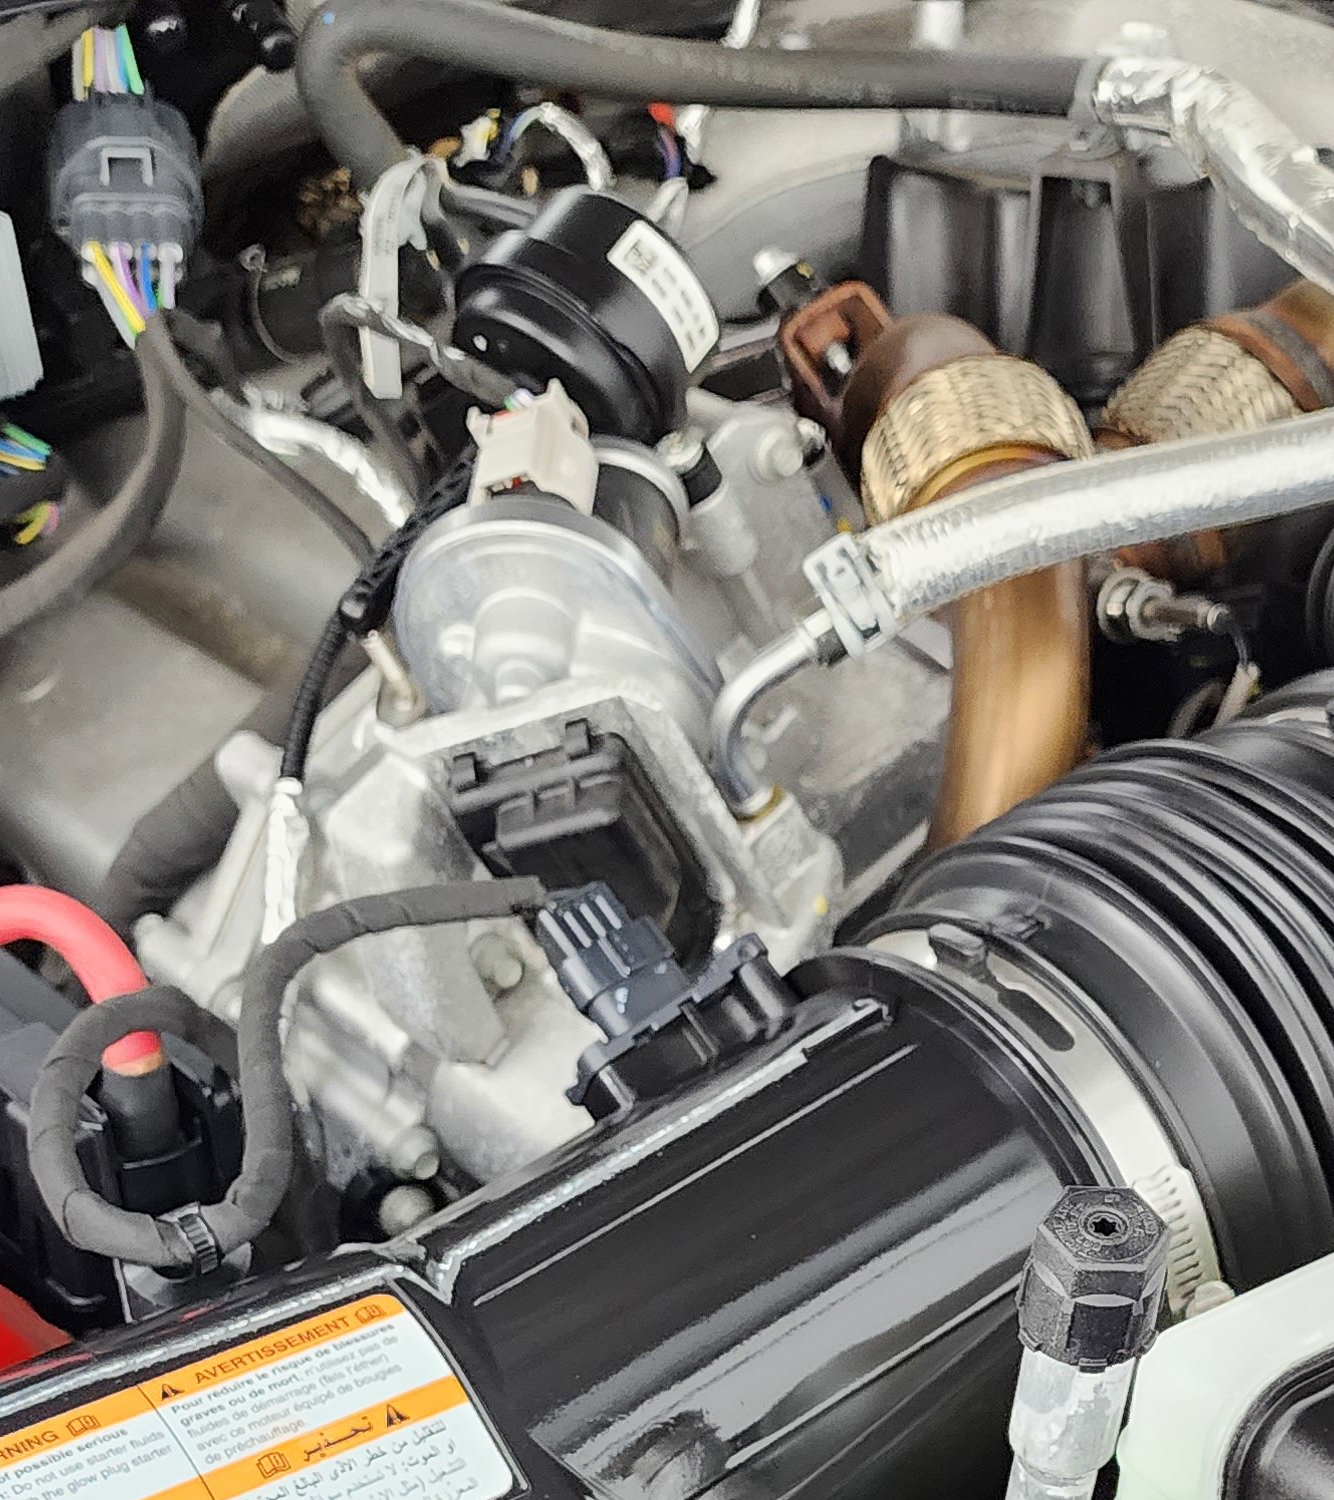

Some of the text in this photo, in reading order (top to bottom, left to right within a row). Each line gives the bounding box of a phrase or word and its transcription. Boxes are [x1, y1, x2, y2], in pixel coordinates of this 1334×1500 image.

[169, 1396, 204, 1415] Pour
[205, 1377, 255, 1402] réduire
[269, 1354, 313, 1376] risque
[330, 1322, 395, 1352] blessures
[193, 1314, 350, 1385] AVERTISSEMENT
[178, 1403, 226, 1428] graves
[356, 1341, 382, 1358] pas
[185, 1415, 231, 1439] fluides
[248, 1381, 318, 1414] démarrage
[195, 1432, 228, 1452] avec
[246, 1406, 291, 1432] moteur
[292, 1387, 336, 1413] équipé
[351, 1362, 403, 1389] bougies
[12, 1448, 74, 1480] possible
[75, 1427, 129, 1453] serious
[32, 1469, 59, 1487] not
[57, 1460, 85, 1477] use
[84, 1442, 128, 1467] starter
[127, 1430, 166, 1450] fluids
[65, 1472, 98, 1495] glow
[98, 1460, 131, 1481] plug
[129, 1443, 172, 1467] starter
